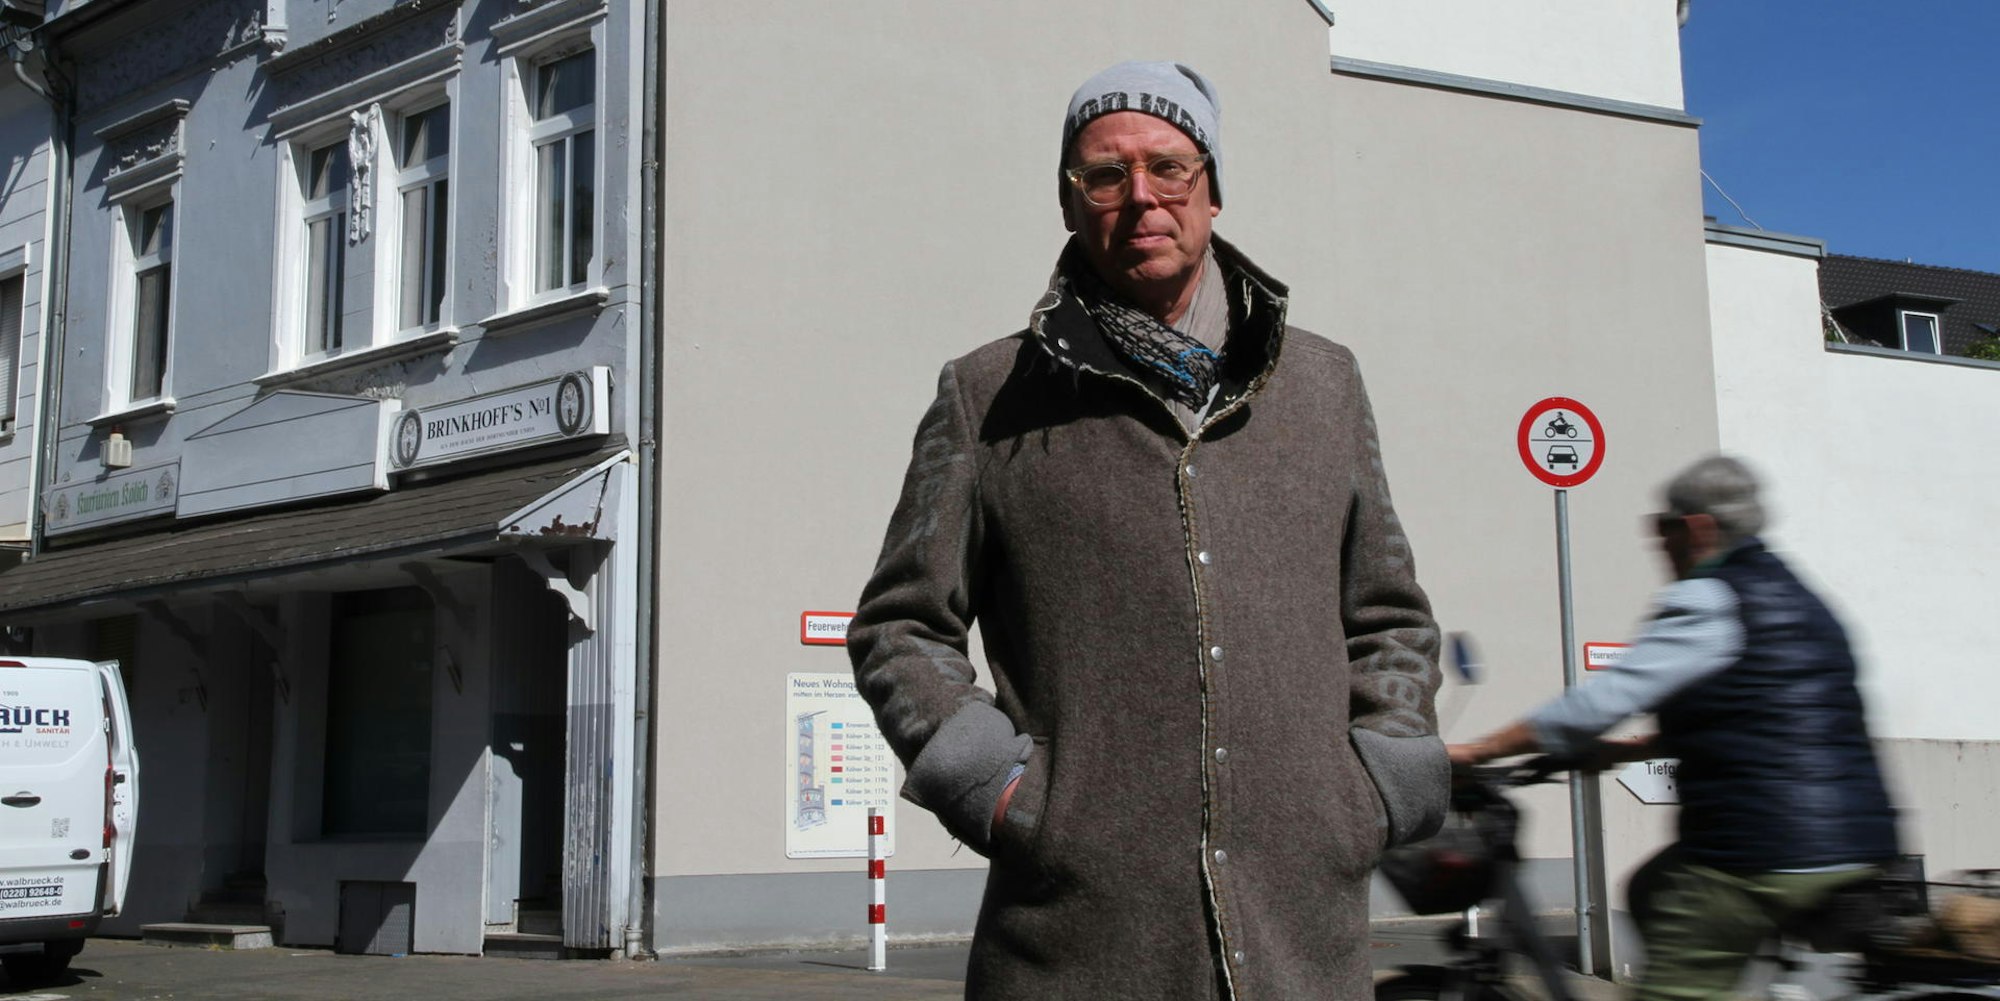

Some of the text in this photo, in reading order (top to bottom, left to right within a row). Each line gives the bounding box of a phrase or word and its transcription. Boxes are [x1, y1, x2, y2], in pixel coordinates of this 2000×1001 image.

[427, 403, 523, 440] BRINKHOFF'S
[794, 679, 857, 691] Neues Wohnq
